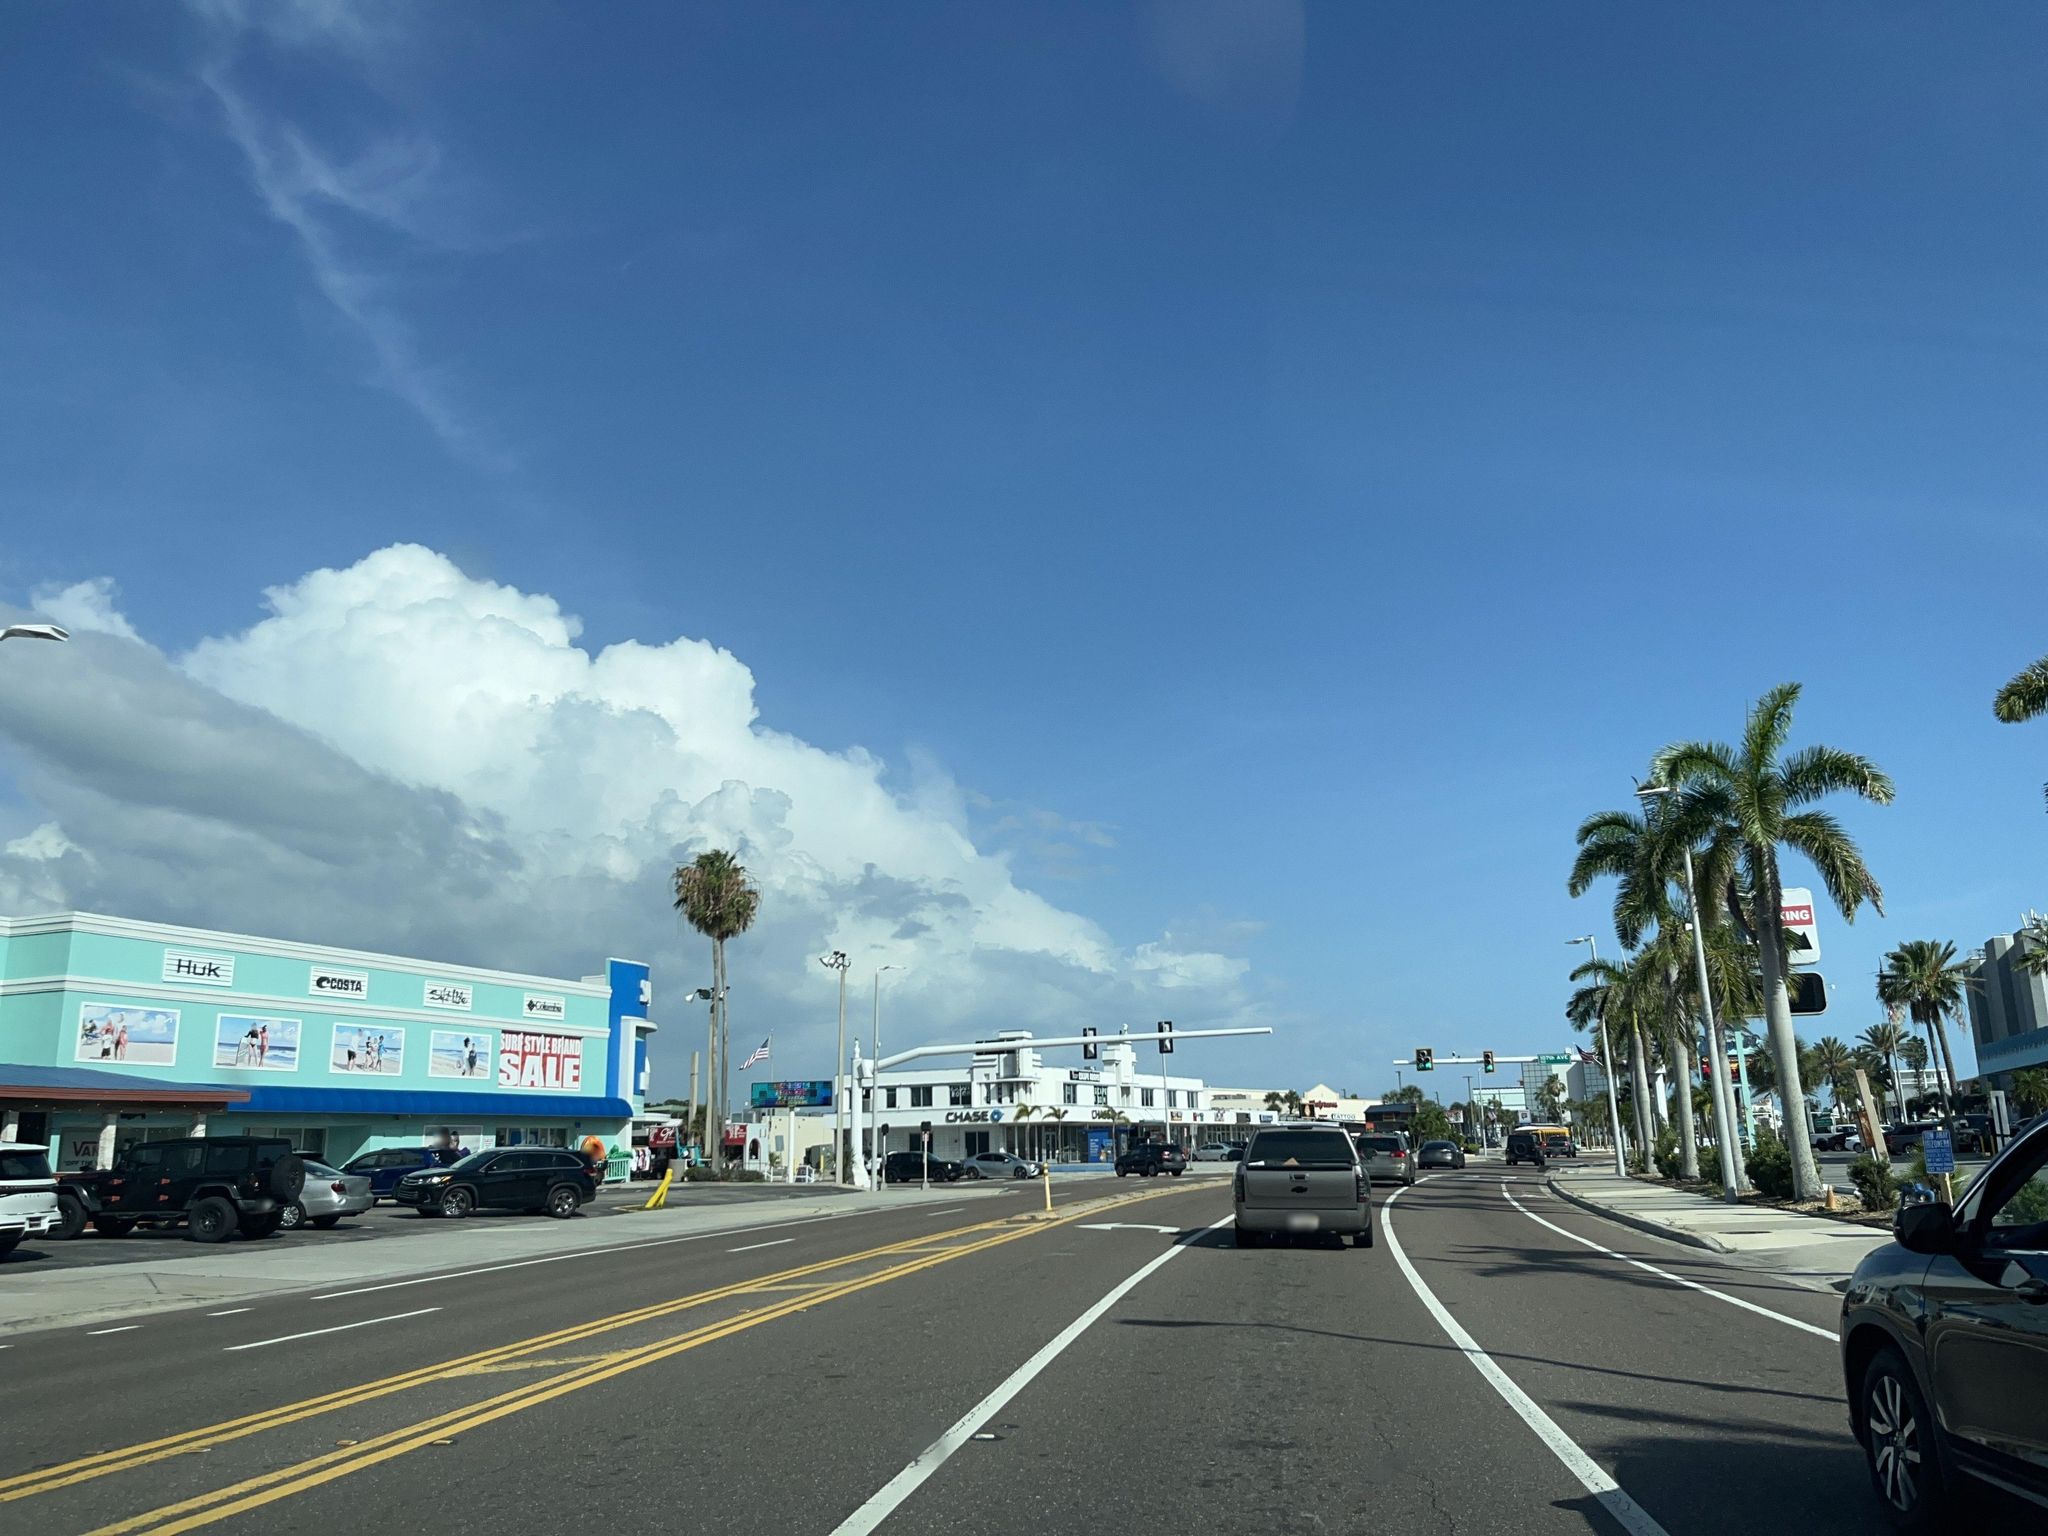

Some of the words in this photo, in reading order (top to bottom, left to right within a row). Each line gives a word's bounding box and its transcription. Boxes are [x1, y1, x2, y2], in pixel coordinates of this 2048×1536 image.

[1780, 910, 1811, 921] KING
[329, 977, 363, 993] COSTA
[500, 1033, 522, 1052] SURF
[524, 1035, 550, 1054] STYLE
[499, 1053, 580, 1089] SALE
[945, 1111, 989, 1123] CHASE
[72, 1141, 99, 1157] VAN
